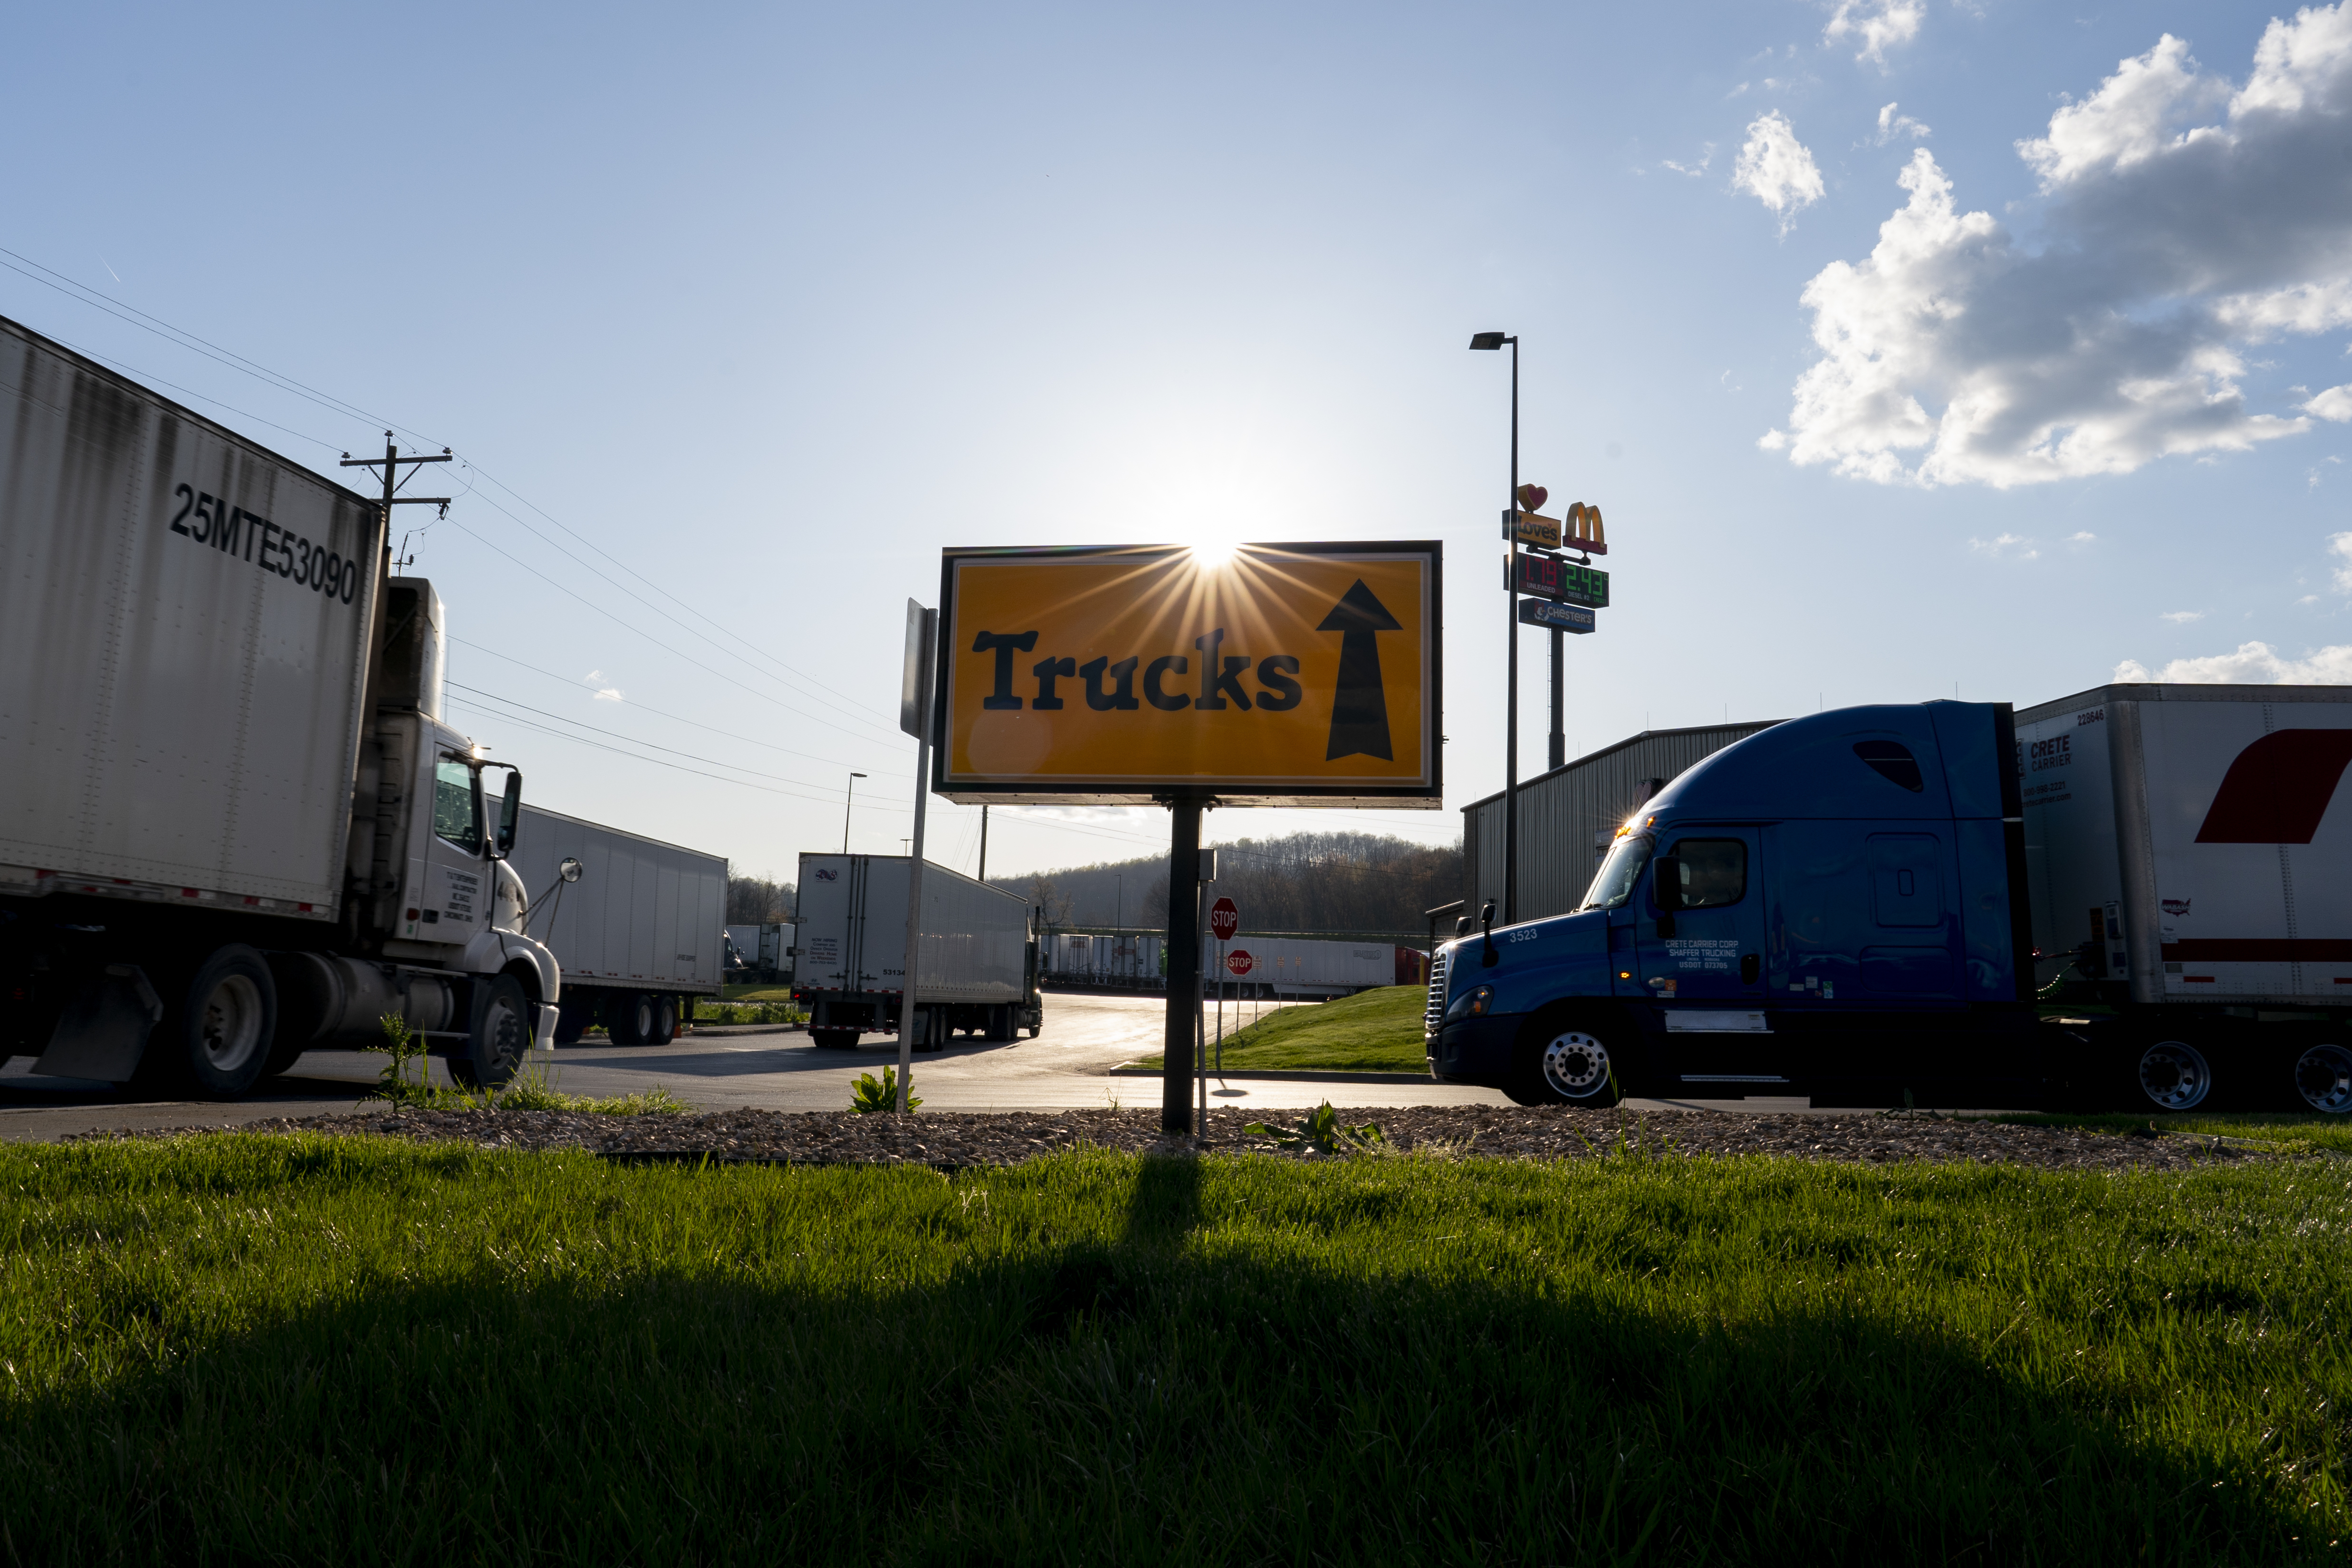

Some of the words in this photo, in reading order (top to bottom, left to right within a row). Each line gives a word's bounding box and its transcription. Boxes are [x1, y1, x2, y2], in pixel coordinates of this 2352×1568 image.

[169, 482, 356, 605] 25MTE53090
[1527, 582, 1555, 593] UNLEADED
[1568, 591, 1583, 599] DIESEL
[972, 628, 1303, 712] Trucks
[2077, 709, 2104, 726] 228646
[2031, 734, 2070, 759] CRETE
[2032, 753, 2071, 772] CARRIER
[1212, 910, 1236, 927] STOP
[1509, 928, 1537, 943] 3523
[1719, 940, 1738, 948] CORP.
[1229, 957, 1251, 967] STOP
